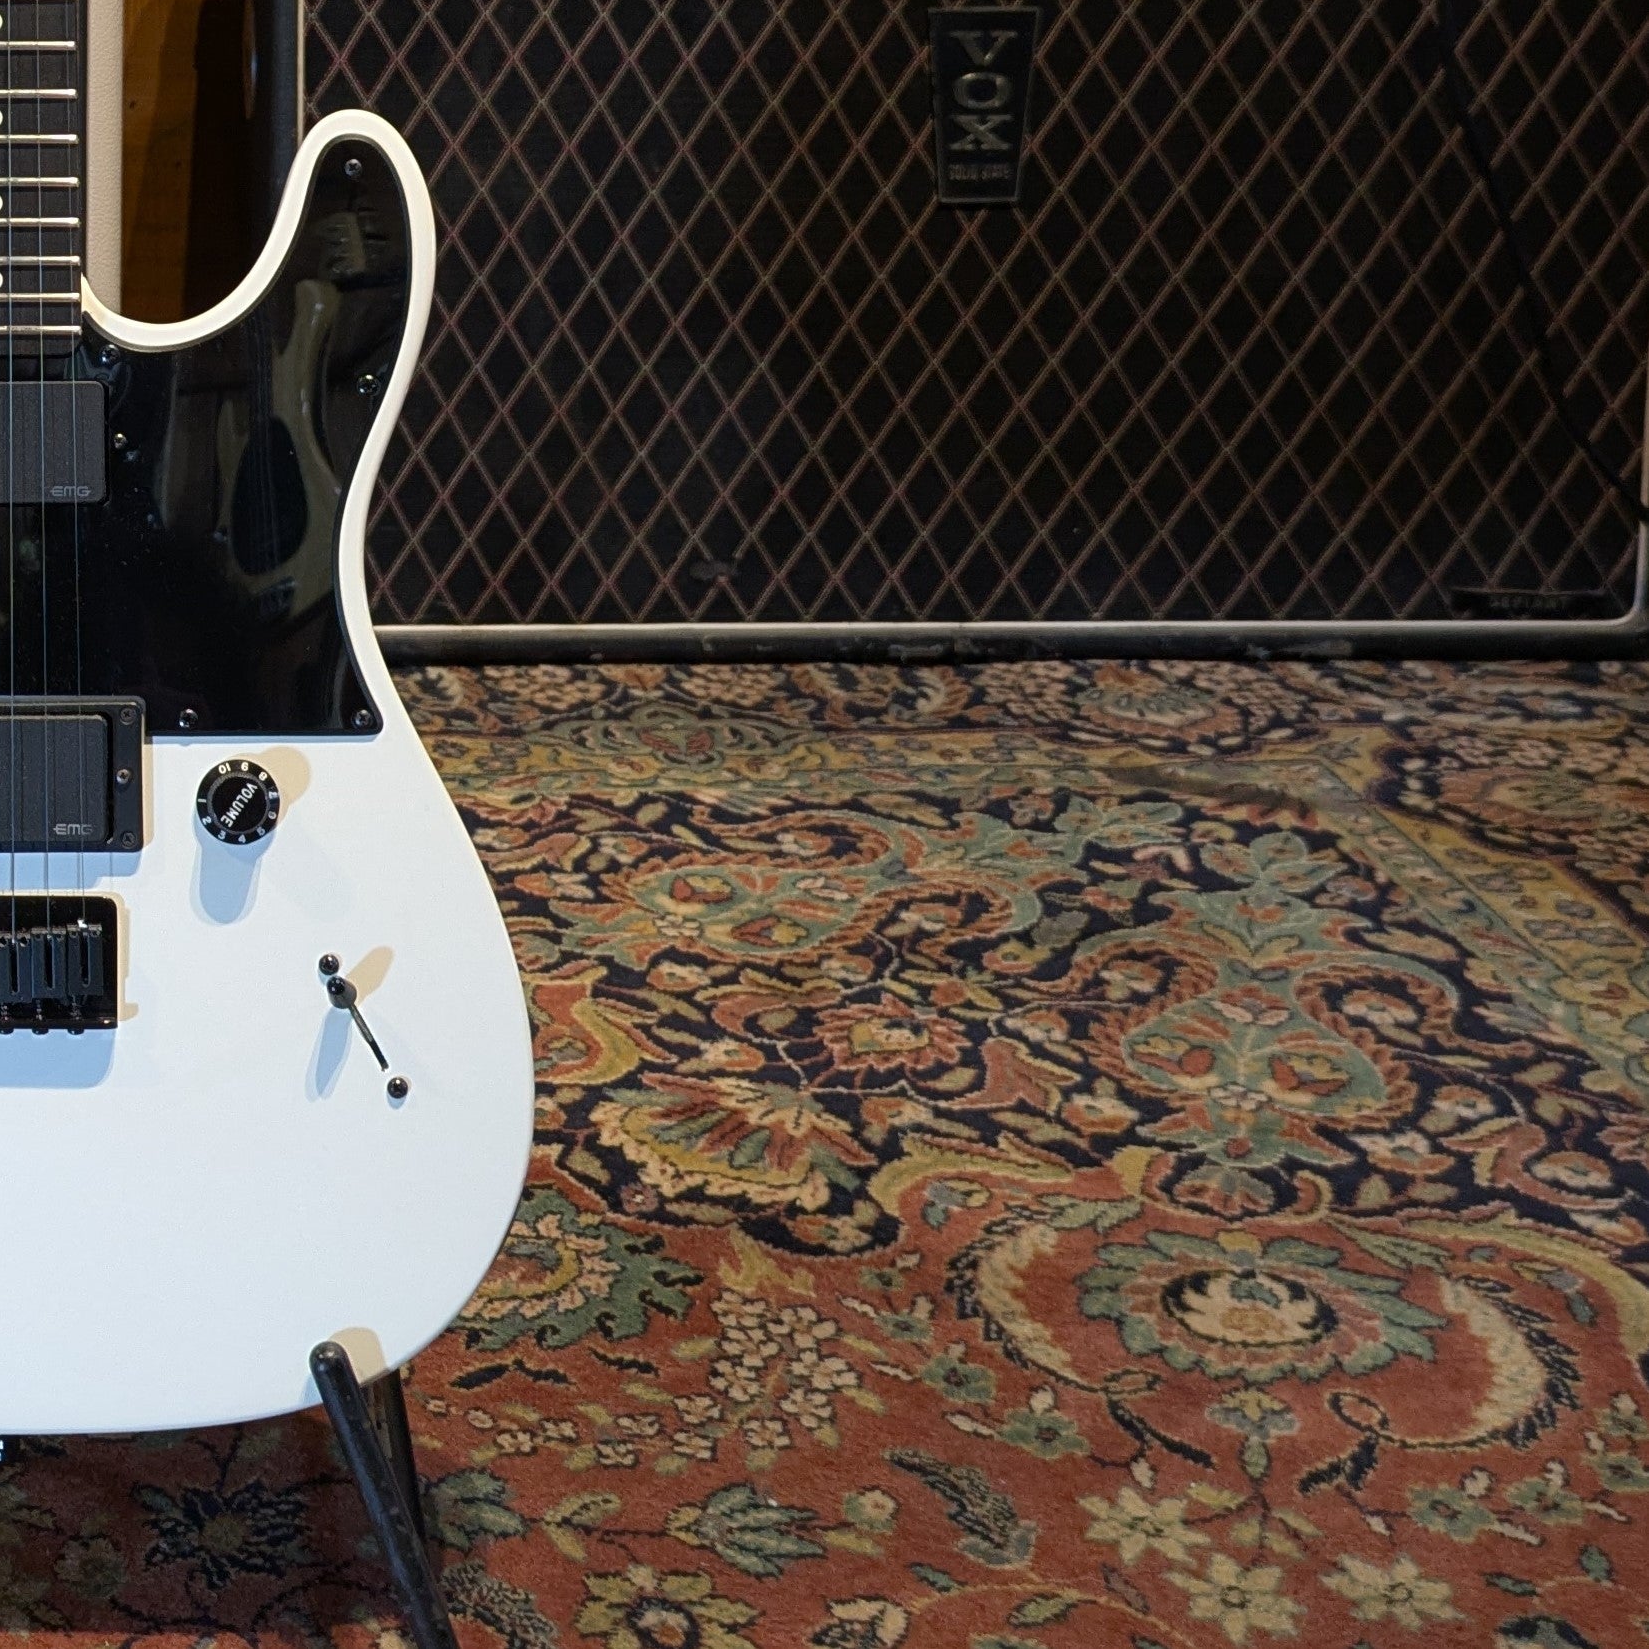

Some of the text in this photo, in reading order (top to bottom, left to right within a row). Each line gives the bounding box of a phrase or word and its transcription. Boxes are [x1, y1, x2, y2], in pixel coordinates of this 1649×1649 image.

[950, 30, 1019, 151] VOX
[51, 485, 92, 498] EMG
[219, 782, 259, 828] VOLUME
[52, 823, 93, 836] EMG
